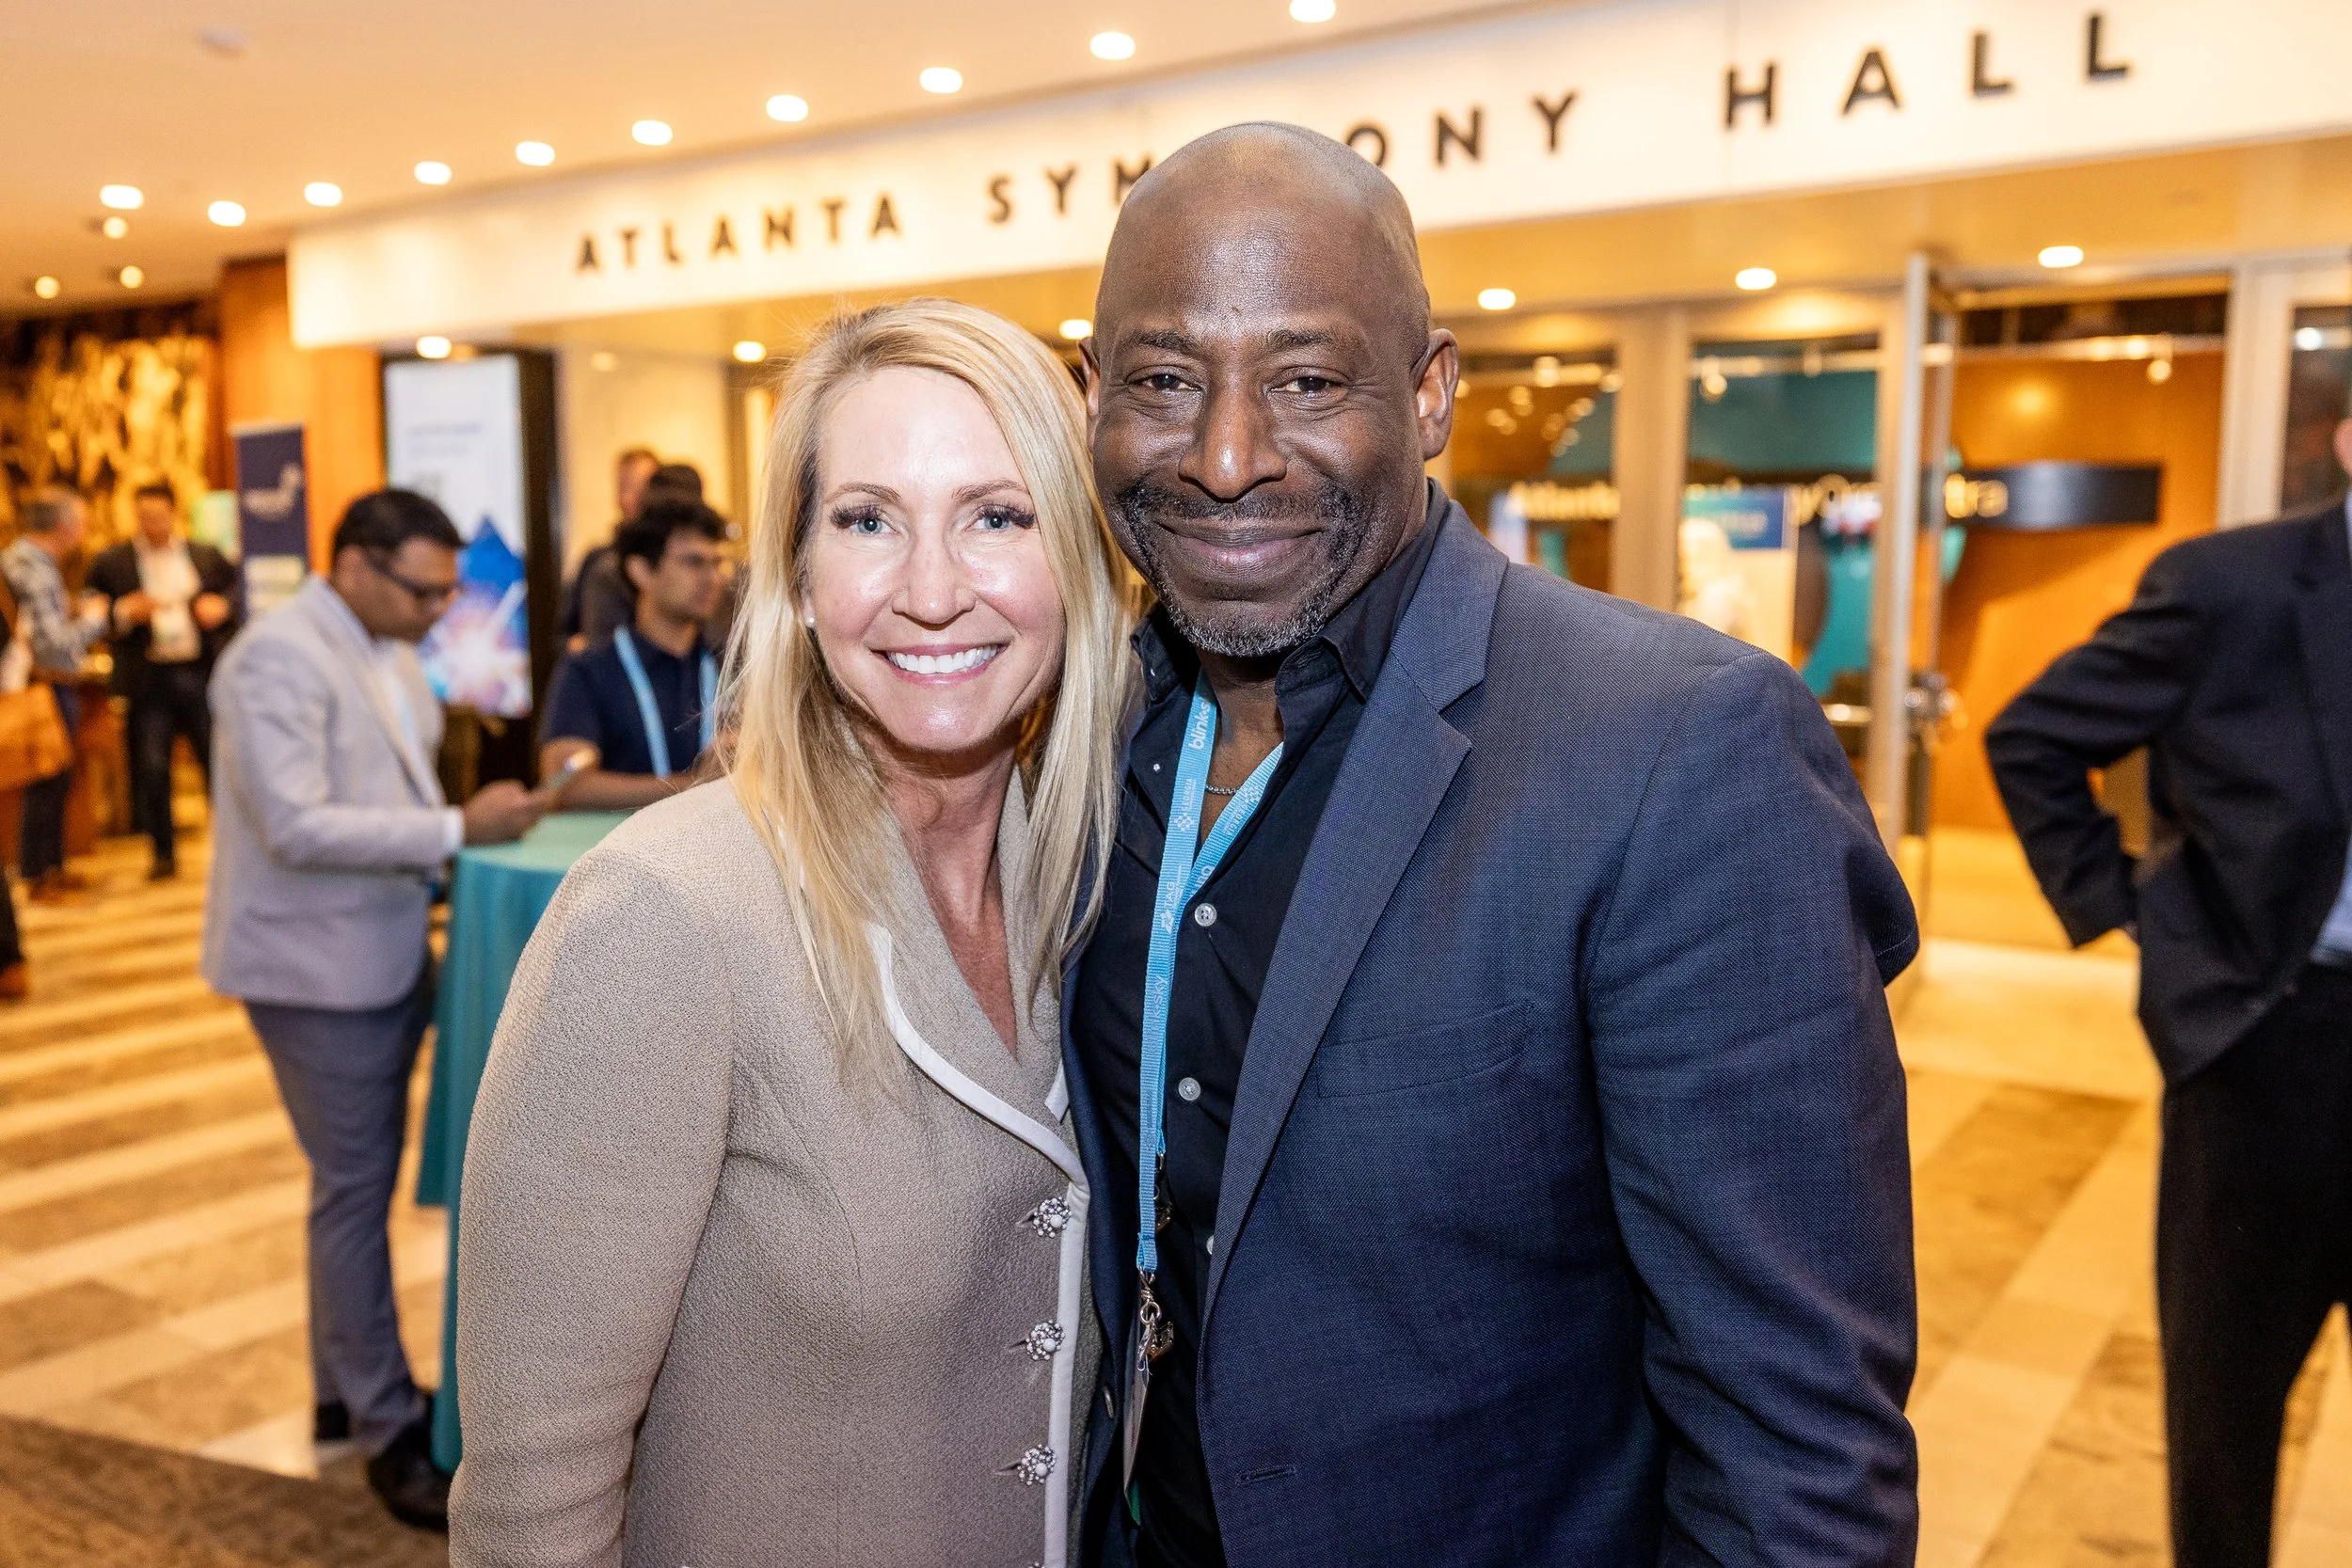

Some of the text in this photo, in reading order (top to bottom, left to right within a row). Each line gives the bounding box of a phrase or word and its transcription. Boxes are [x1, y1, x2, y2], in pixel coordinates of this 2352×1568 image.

[576, 12, 2130, 272] ATLANTA SYMONY HALL
[1182, 778, 1193, 811] GEORGIA
[1225, 803, 1248, 836] GEORGIA
[1164, 881, 1175, 909] TAG
